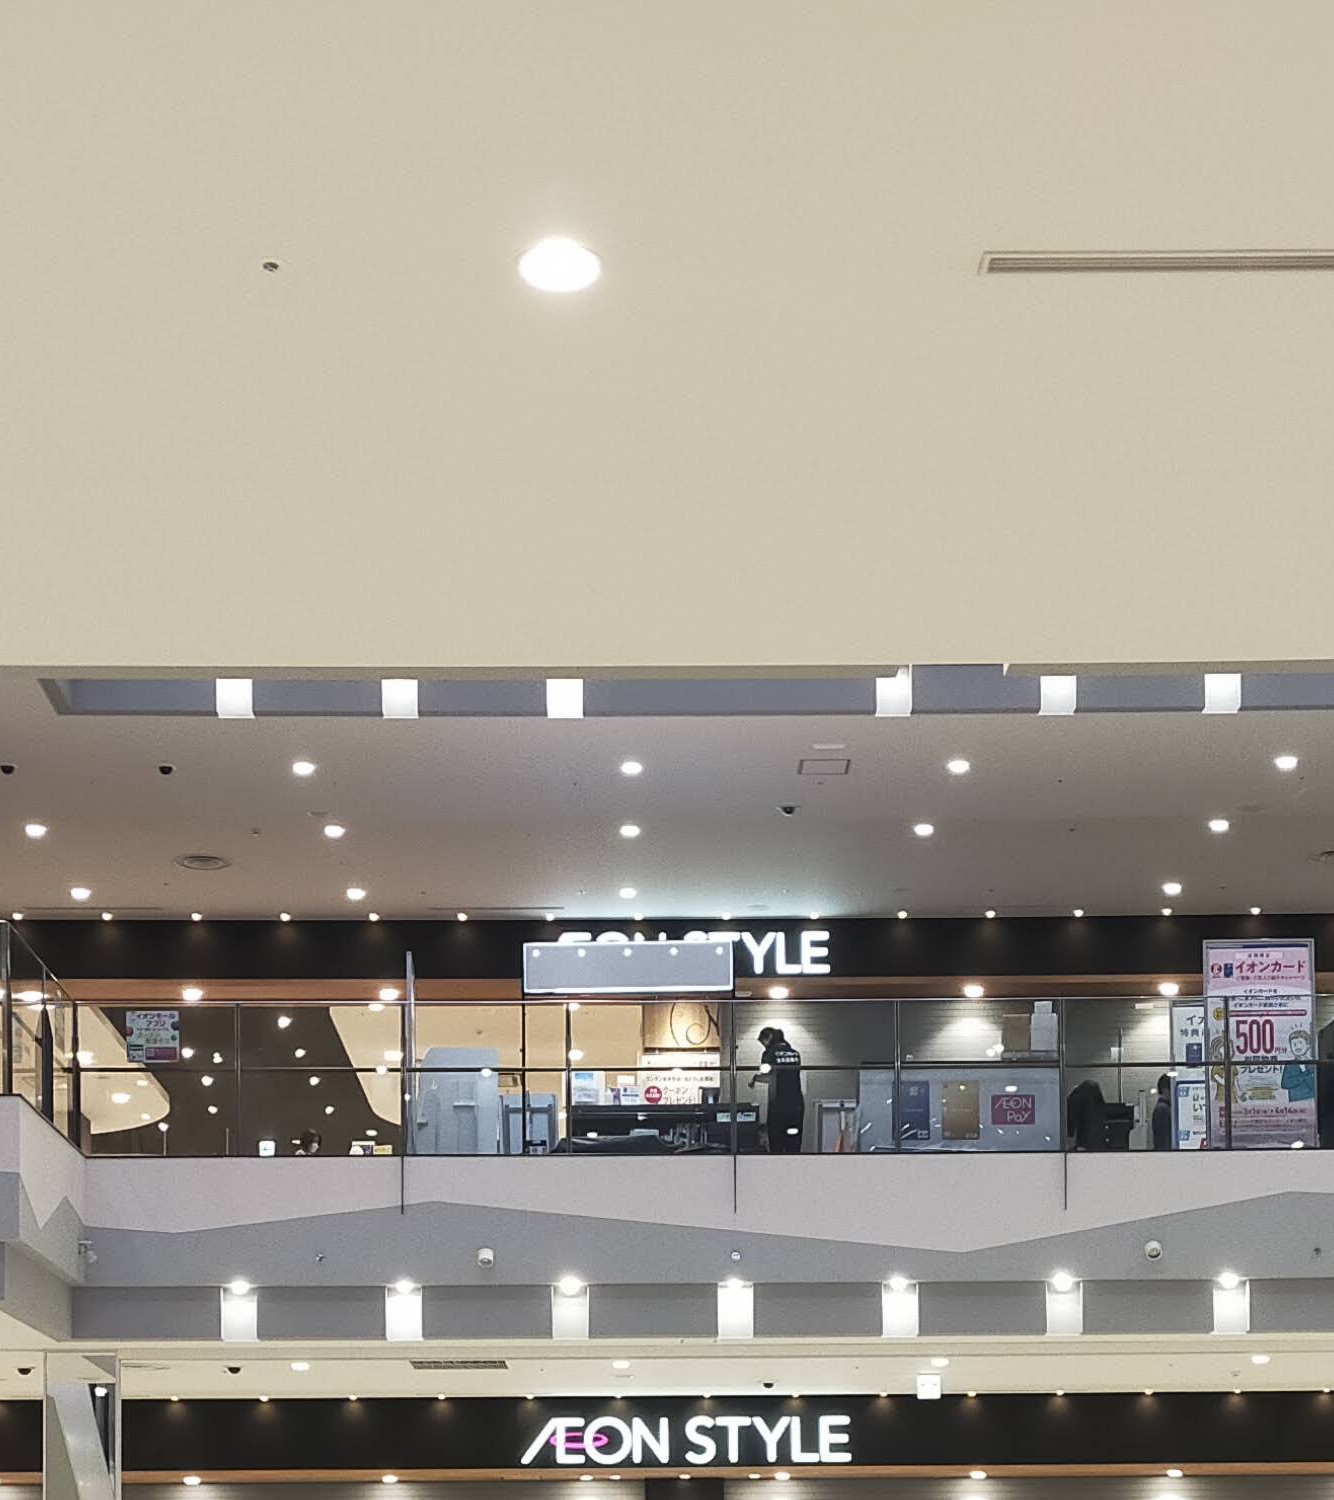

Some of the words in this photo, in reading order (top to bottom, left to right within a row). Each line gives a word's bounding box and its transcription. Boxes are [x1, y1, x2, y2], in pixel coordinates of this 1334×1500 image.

[1235, 960, 1306, 974] イオンカード
[1236, 1019, 1275, 1055] 500
[684, 1414, 852, 1465] STYLE
